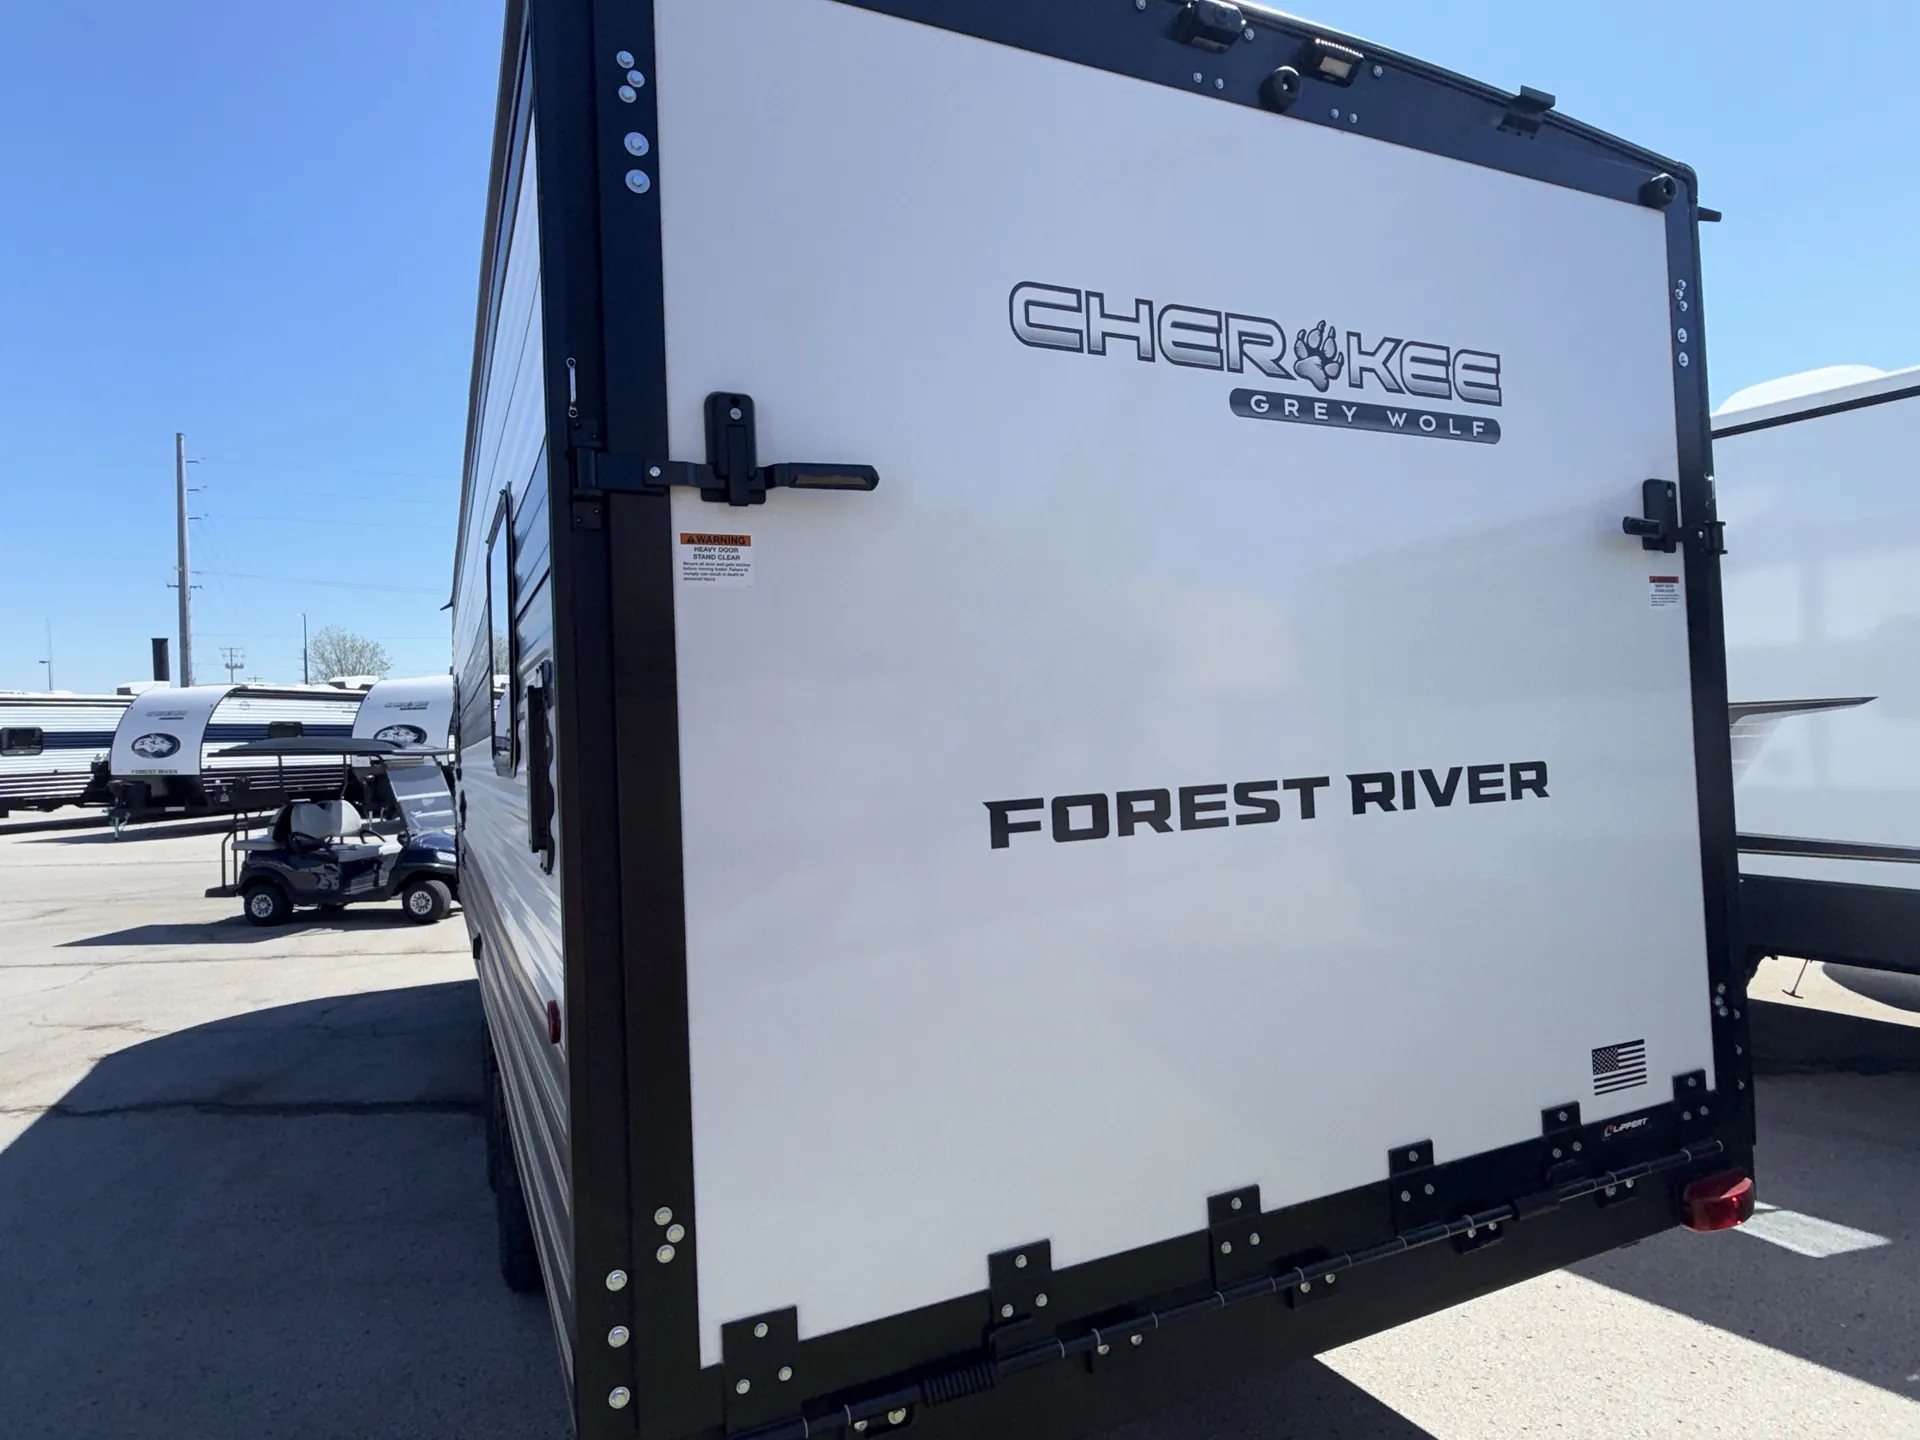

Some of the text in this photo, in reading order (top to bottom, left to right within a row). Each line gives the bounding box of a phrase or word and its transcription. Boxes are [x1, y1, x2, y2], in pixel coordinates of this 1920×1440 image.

[1250, 394, 1486, 438] GREY WOLF
[696, 535, 746, 545] WARNING
[982, 760, 1550, 849] FOREST RIVER
